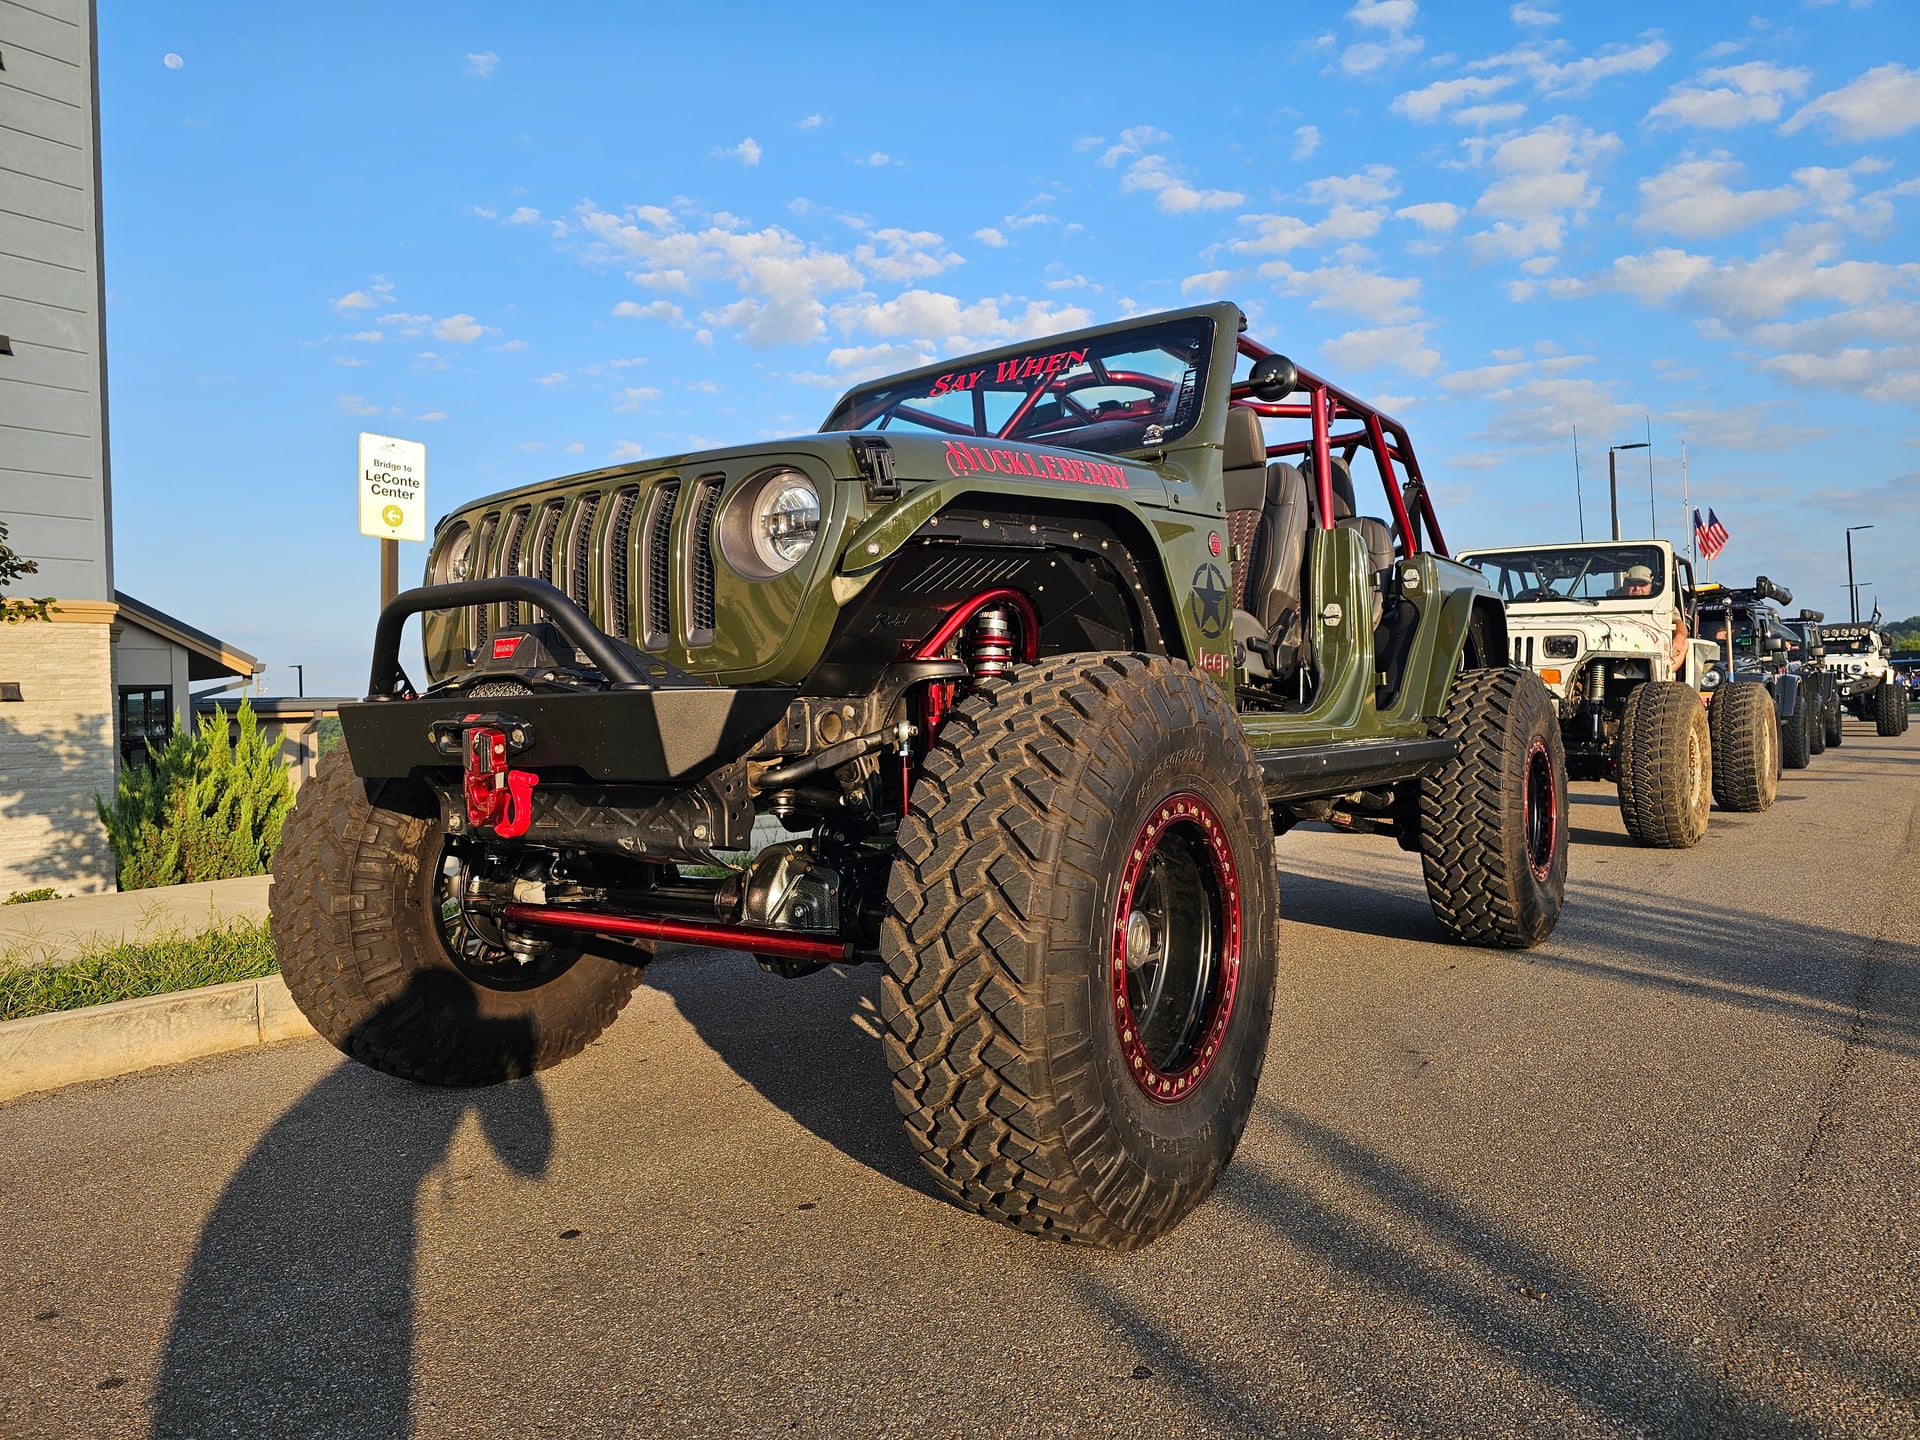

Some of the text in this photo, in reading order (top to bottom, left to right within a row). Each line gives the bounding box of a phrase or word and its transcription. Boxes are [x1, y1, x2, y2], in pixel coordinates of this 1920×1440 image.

[929, 348, 1089, 397] SAY WHEN
[373, 459, 401, 471] Bridge
[941, 440, 1129, 490] HUCKLEBERRY
[365, 469, 420, 488] LeConte
[371, 484, 415, 500] Center
[1195, 647, 1230, 678] Jeep
